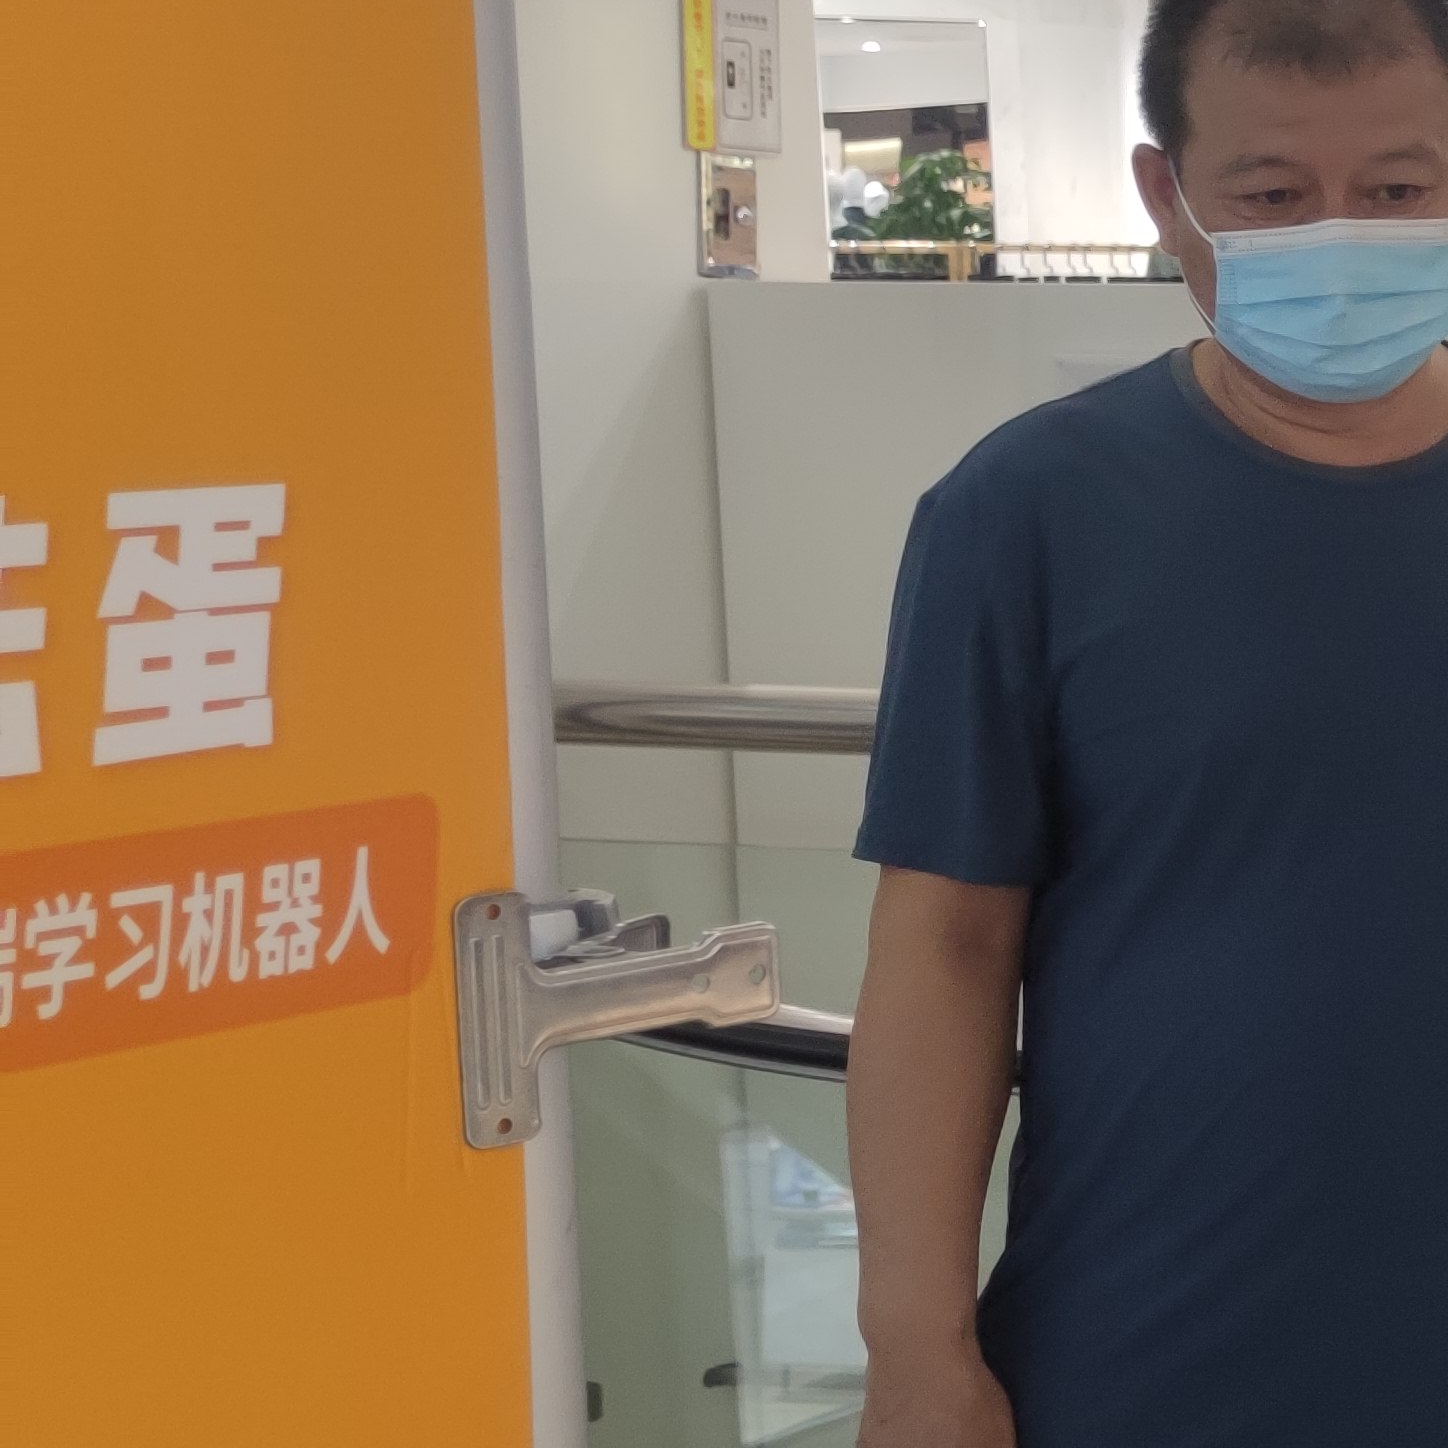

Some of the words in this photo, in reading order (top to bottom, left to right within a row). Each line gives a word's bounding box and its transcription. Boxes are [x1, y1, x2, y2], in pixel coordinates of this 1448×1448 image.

[0, 482, 286, 778] 蛋
[0, 845, 392, 1029] 学习机器人
